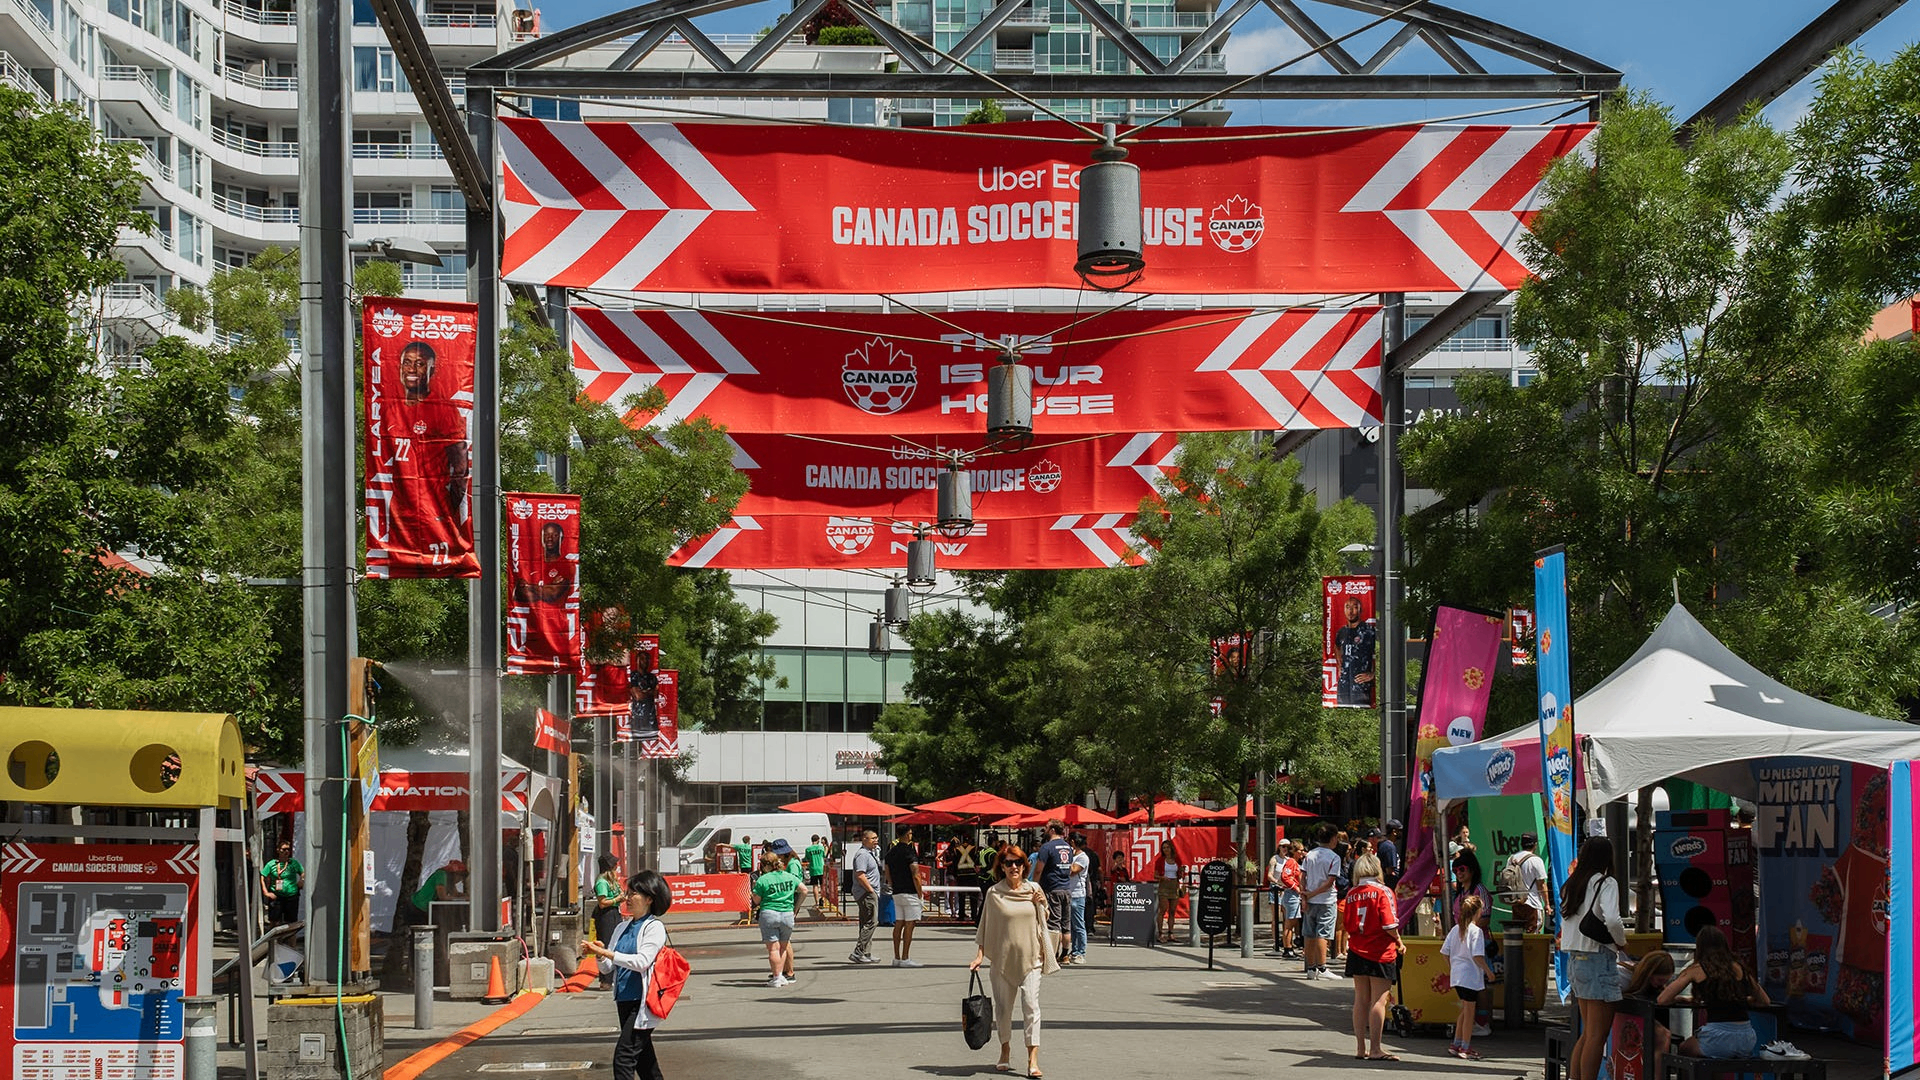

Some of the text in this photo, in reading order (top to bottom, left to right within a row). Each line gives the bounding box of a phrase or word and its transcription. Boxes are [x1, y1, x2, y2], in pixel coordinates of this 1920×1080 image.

[978, 163, 1081, 192] Uber Ea
[832, 206, 960, 246] CANADA
[1142, 207, 1203, 246] USE
[1210, 220, 1263, 231] CANADA
[411, 313, 456, 324] OUR
[411, 322, 472, 333] GAME
[411, 330, 460, 340] NOW
[843, 371, 916, 384] CANADA
[940, 363, 1104, 386] IS UR
[371, 346, 381, 457] LARYEA
[941, 393, 1114, 416] HSE
[394, 437, 411, 462] 22
[805, 464, 881, 490] CANADA
[825, 527, 875, 535] CANADA
[428, 541, 452, 566] 22
[509, 523, 520, 573] KONÉ
[890, 541, 969, 557] NW
[1451, 728, 1473, 739] NEW
[1810, 765, 1840, 778] YOUR
[1759, 778, 1839, 803] MIGHTY
[1759, 803, 1836, 850] FAN
[88, 854, 124, 862] Uber Eats
[1193, 856, 1211, 864] Uber
[1728, 848, 1748, 865] FAN
[52, 862, 84, 873] CANADA
[86, 863, 117, 873] SOCCER
[118, 863, 144, 873] HOUSE
[769, 880, 794, 894] STAFF
[672, 897, 725, 905] HOUSE
[1357, 906, 1367, 934] 7
